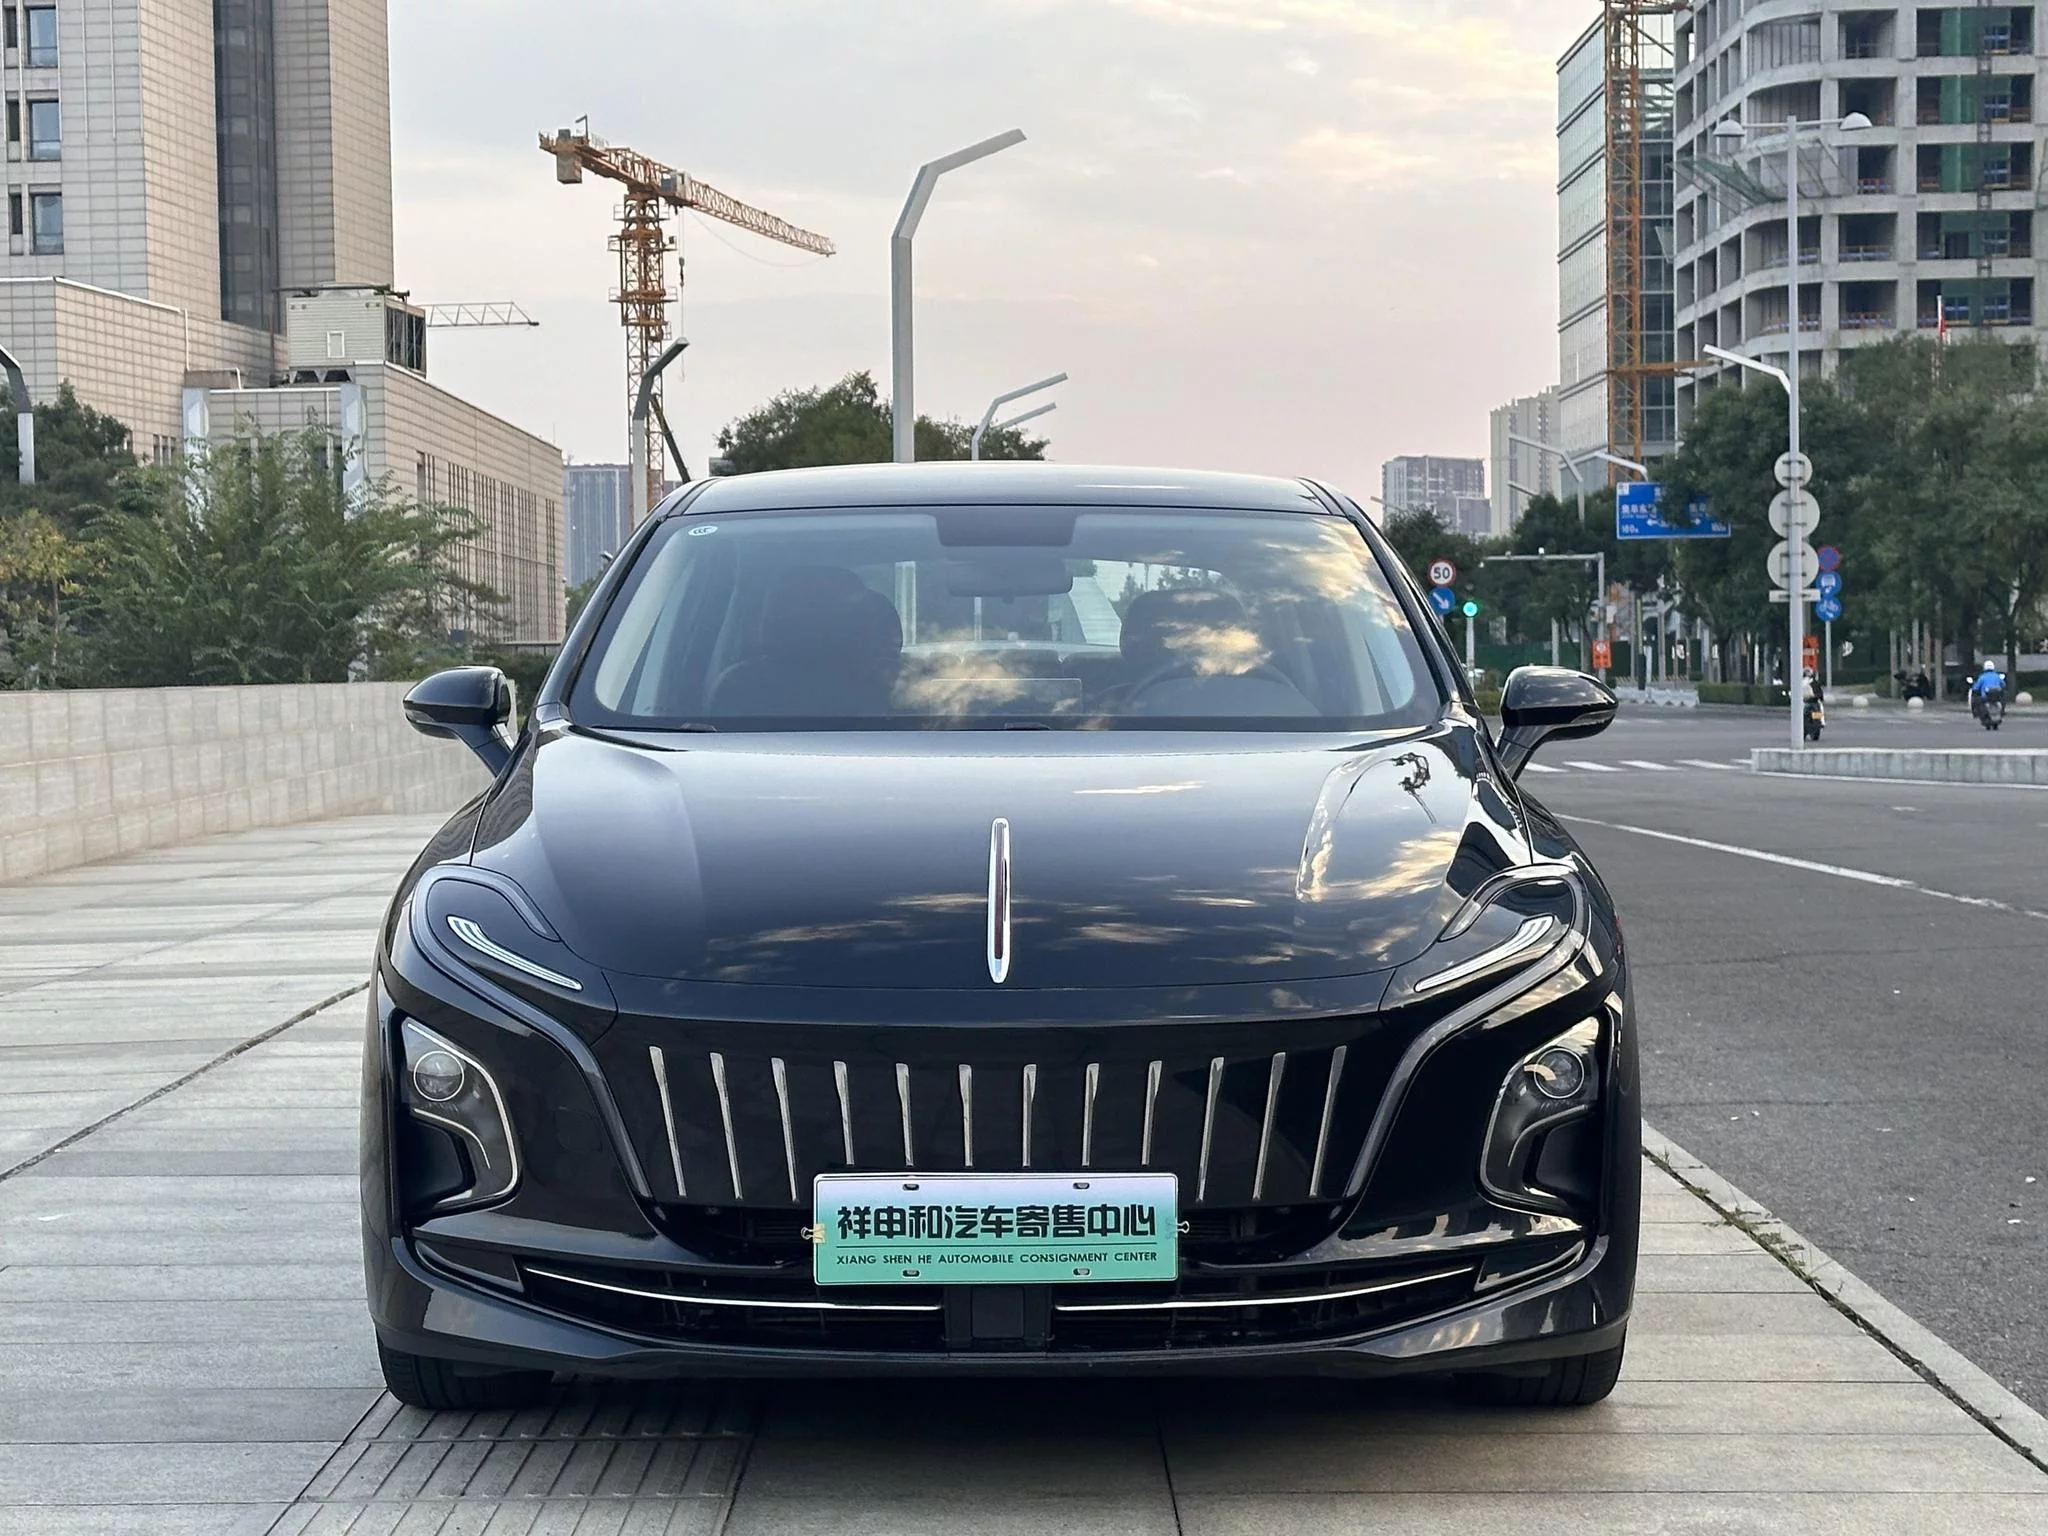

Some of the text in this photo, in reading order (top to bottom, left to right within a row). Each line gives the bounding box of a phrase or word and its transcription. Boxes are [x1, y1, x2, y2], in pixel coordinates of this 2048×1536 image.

[1434, 566, 1450, 580] 50
[837, 1204, 1156, 1239] 祥申和汽车寄售中心
[837, 1251, 1157, 1265] XIANG SHEN HE AUTOMOBILE CONSIGNMENT CENTER
